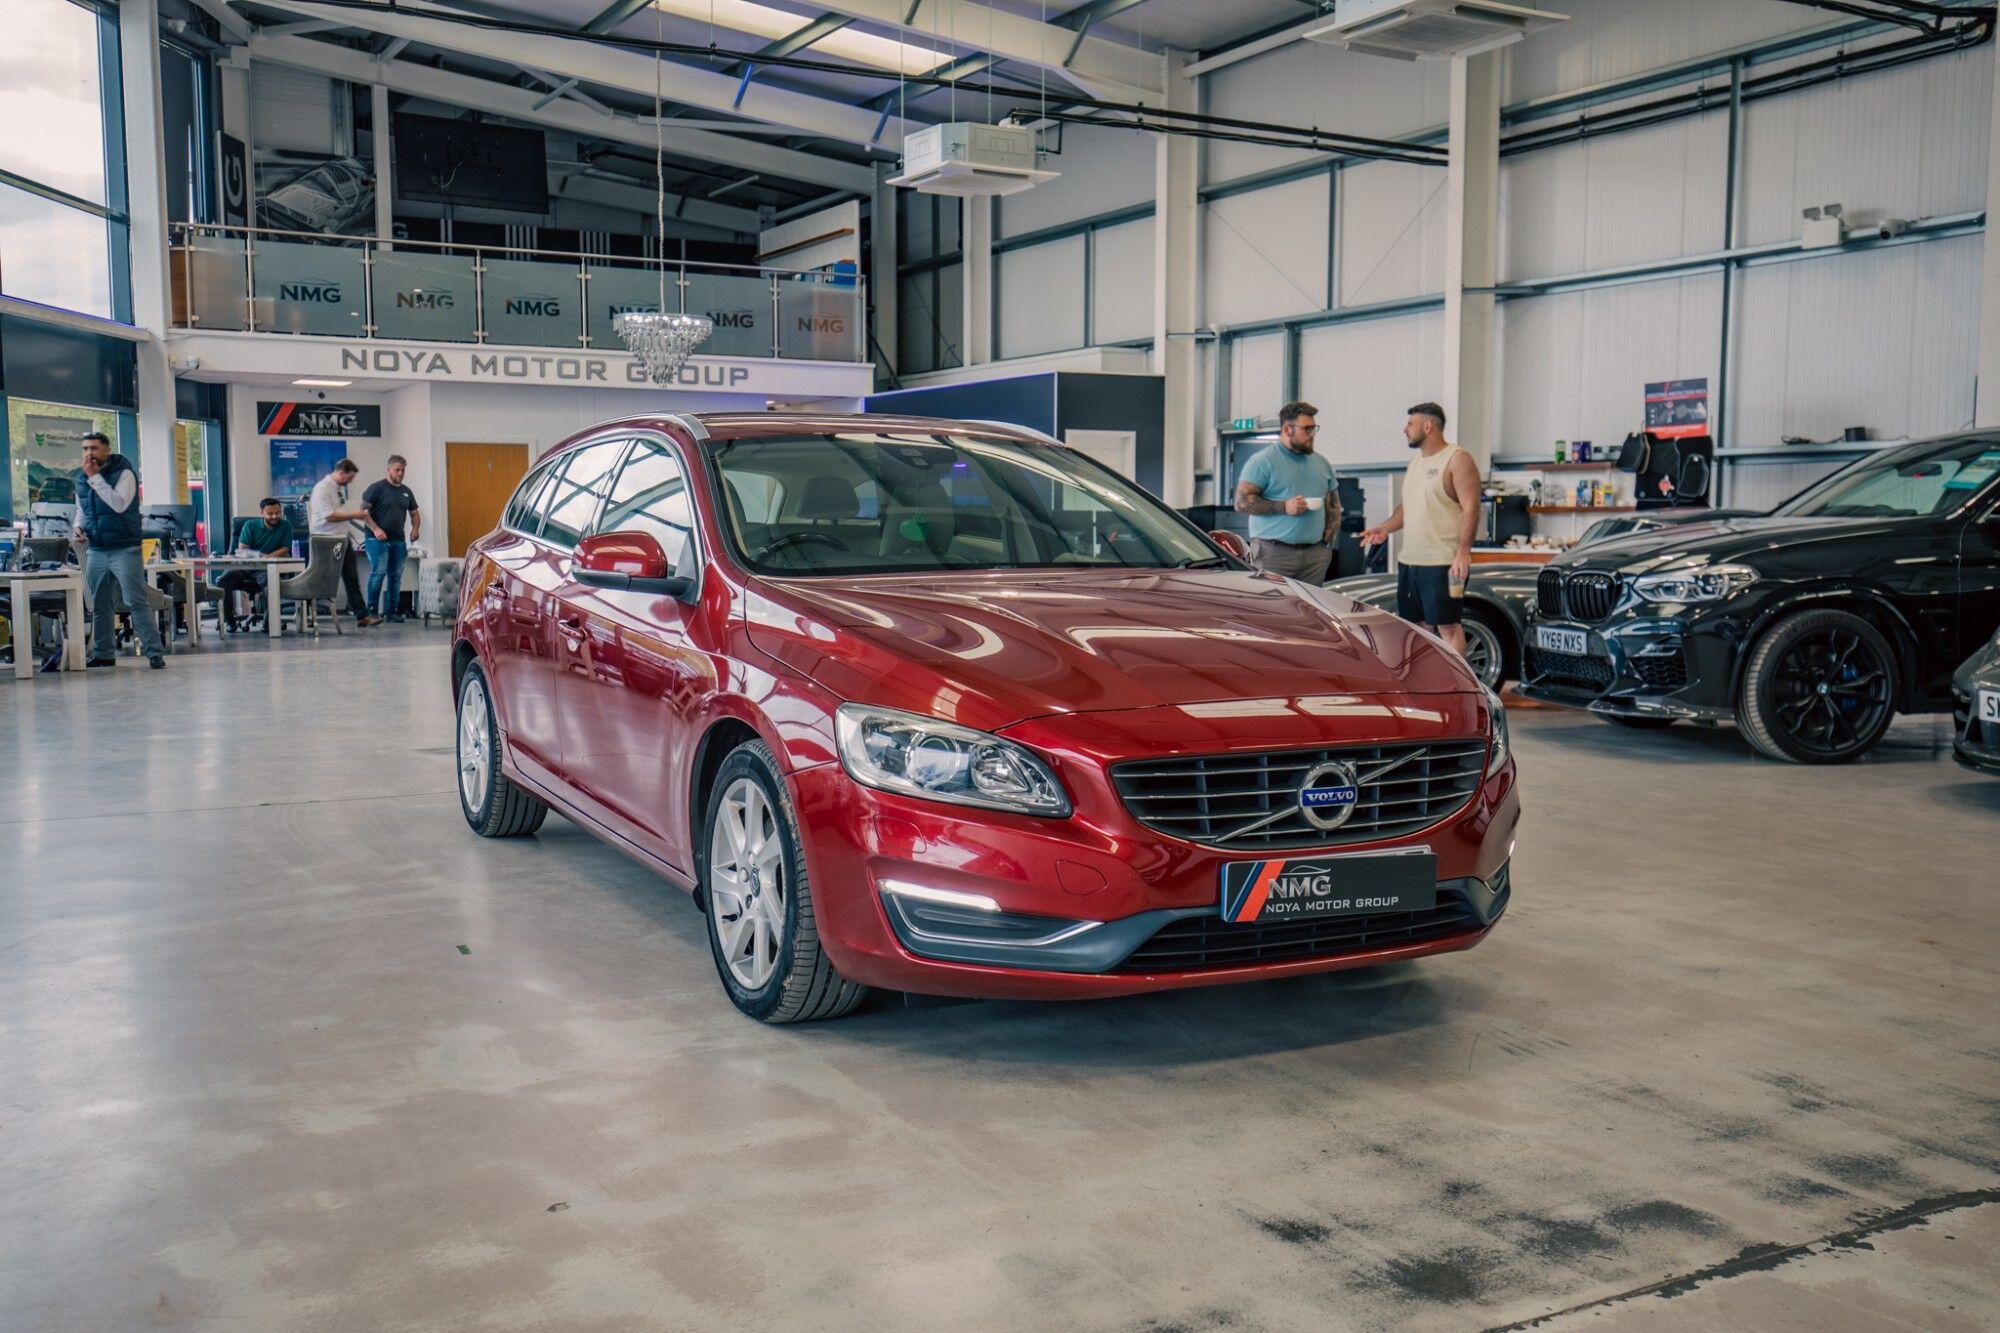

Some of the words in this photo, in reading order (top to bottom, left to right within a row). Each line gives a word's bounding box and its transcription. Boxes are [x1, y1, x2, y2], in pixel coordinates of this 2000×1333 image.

[280, 285, 341, 303] NMG
[396, 292, 454, 309] NMG
[506, 300, 560, 317] NMG
[706, 311, 754, 328] NMG
[799, 317, 844, 333] NMG
[342, 348, 452, 374] NOYA
[471, 354, 608, 381] MOTOR
[627, 362, 749, 387] GOUP
[298, 413, 358, 430] NMG
[1540, 630, 1562, 650] YY69
[1564, 633, 1583, 652] NXS
[1306, 790, 1354, 802] VOLVO
[1268, 875, 1332, 899] NMG
[1266, 902, 1301, 914] NOYA
[1306, 899, 1350, 911] MOTOR
[1356, 896, 1399, 908] GROUP
